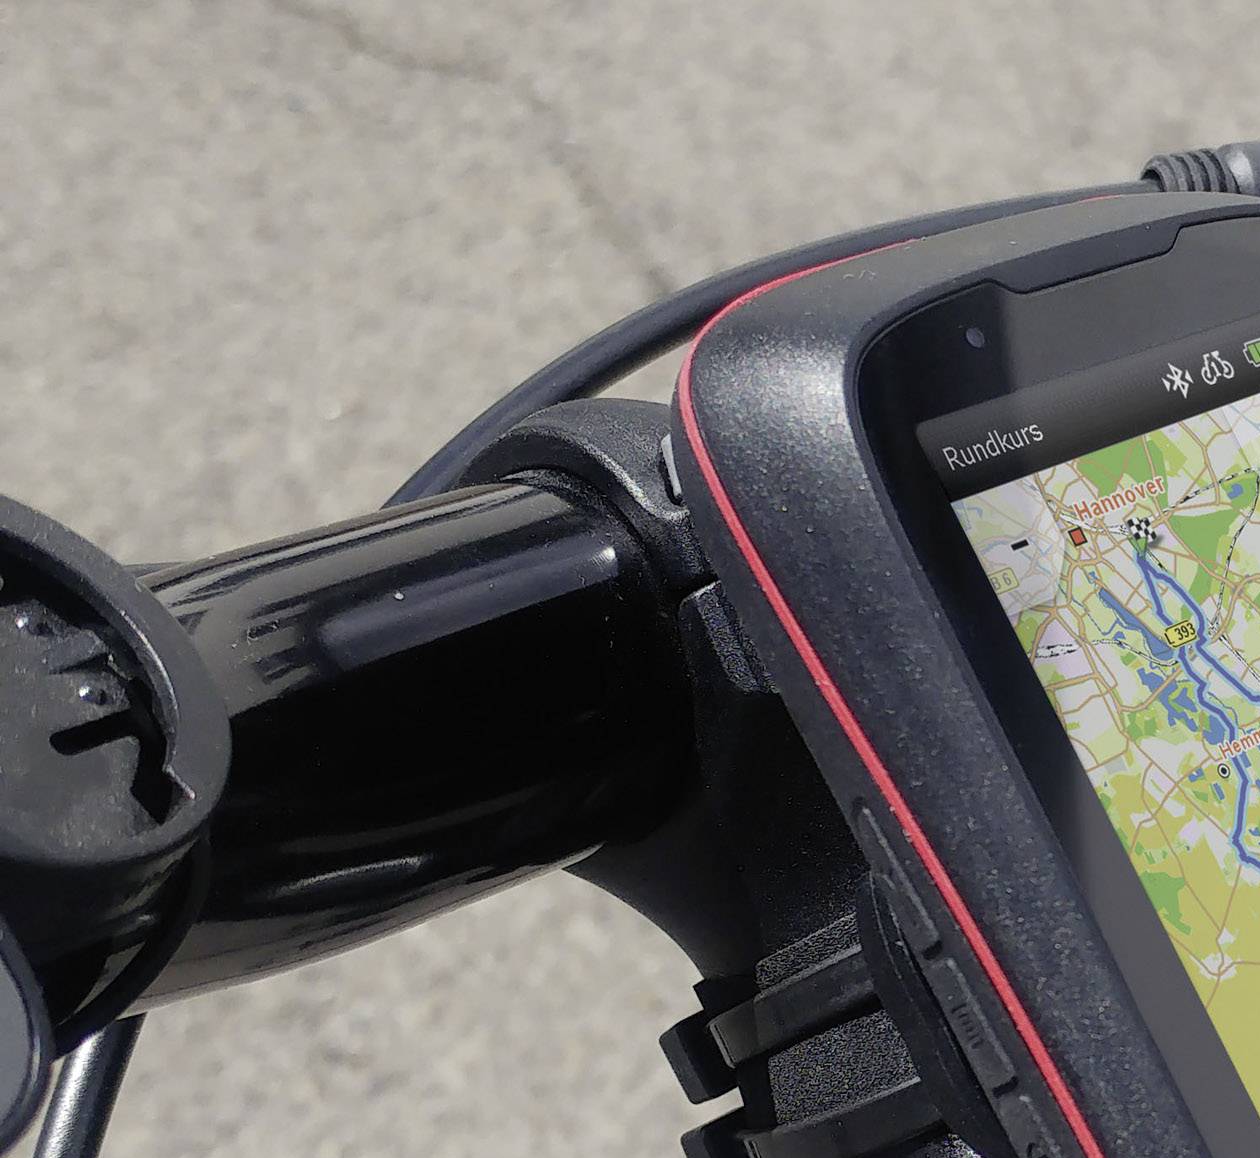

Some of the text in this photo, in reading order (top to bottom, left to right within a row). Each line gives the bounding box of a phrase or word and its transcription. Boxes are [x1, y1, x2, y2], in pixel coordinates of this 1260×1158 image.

[942, 422, 1044, 471] Rundkurs
[1073, 476, 1166, 521] Hannover
[1002, 571, 1012, 586] 6
[1164, 622, 1197, 646] L 393
